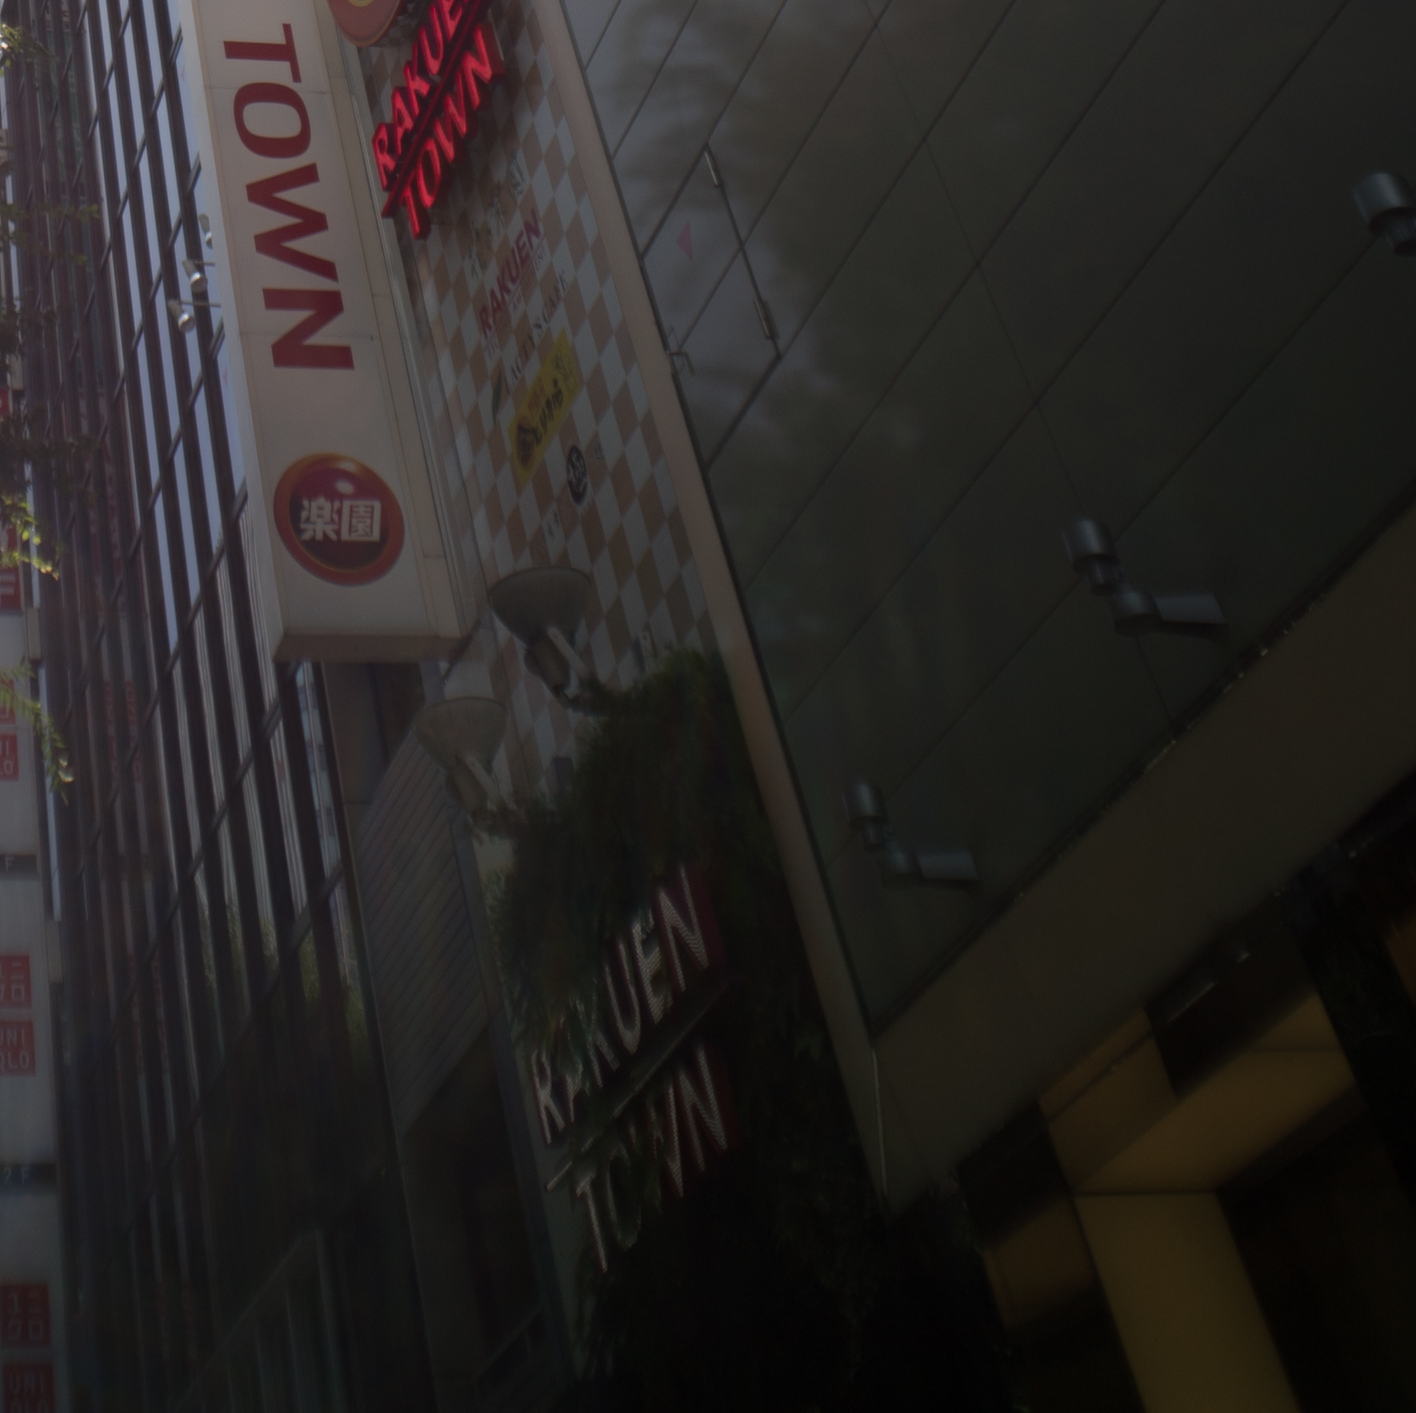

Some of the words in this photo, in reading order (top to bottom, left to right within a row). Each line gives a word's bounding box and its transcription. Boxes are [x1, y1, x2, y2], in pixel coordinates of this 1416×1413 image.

[222, 23, 356, 370] TOWN
[399, 24, 493, 239] TOWN
[479, 207, 543, 339] RAKUEN
[298, 498, 382, 544] 楽園
[531, 863, 710, 1146] RAKUEN
[8, 1372, 46, 1396] UNI
